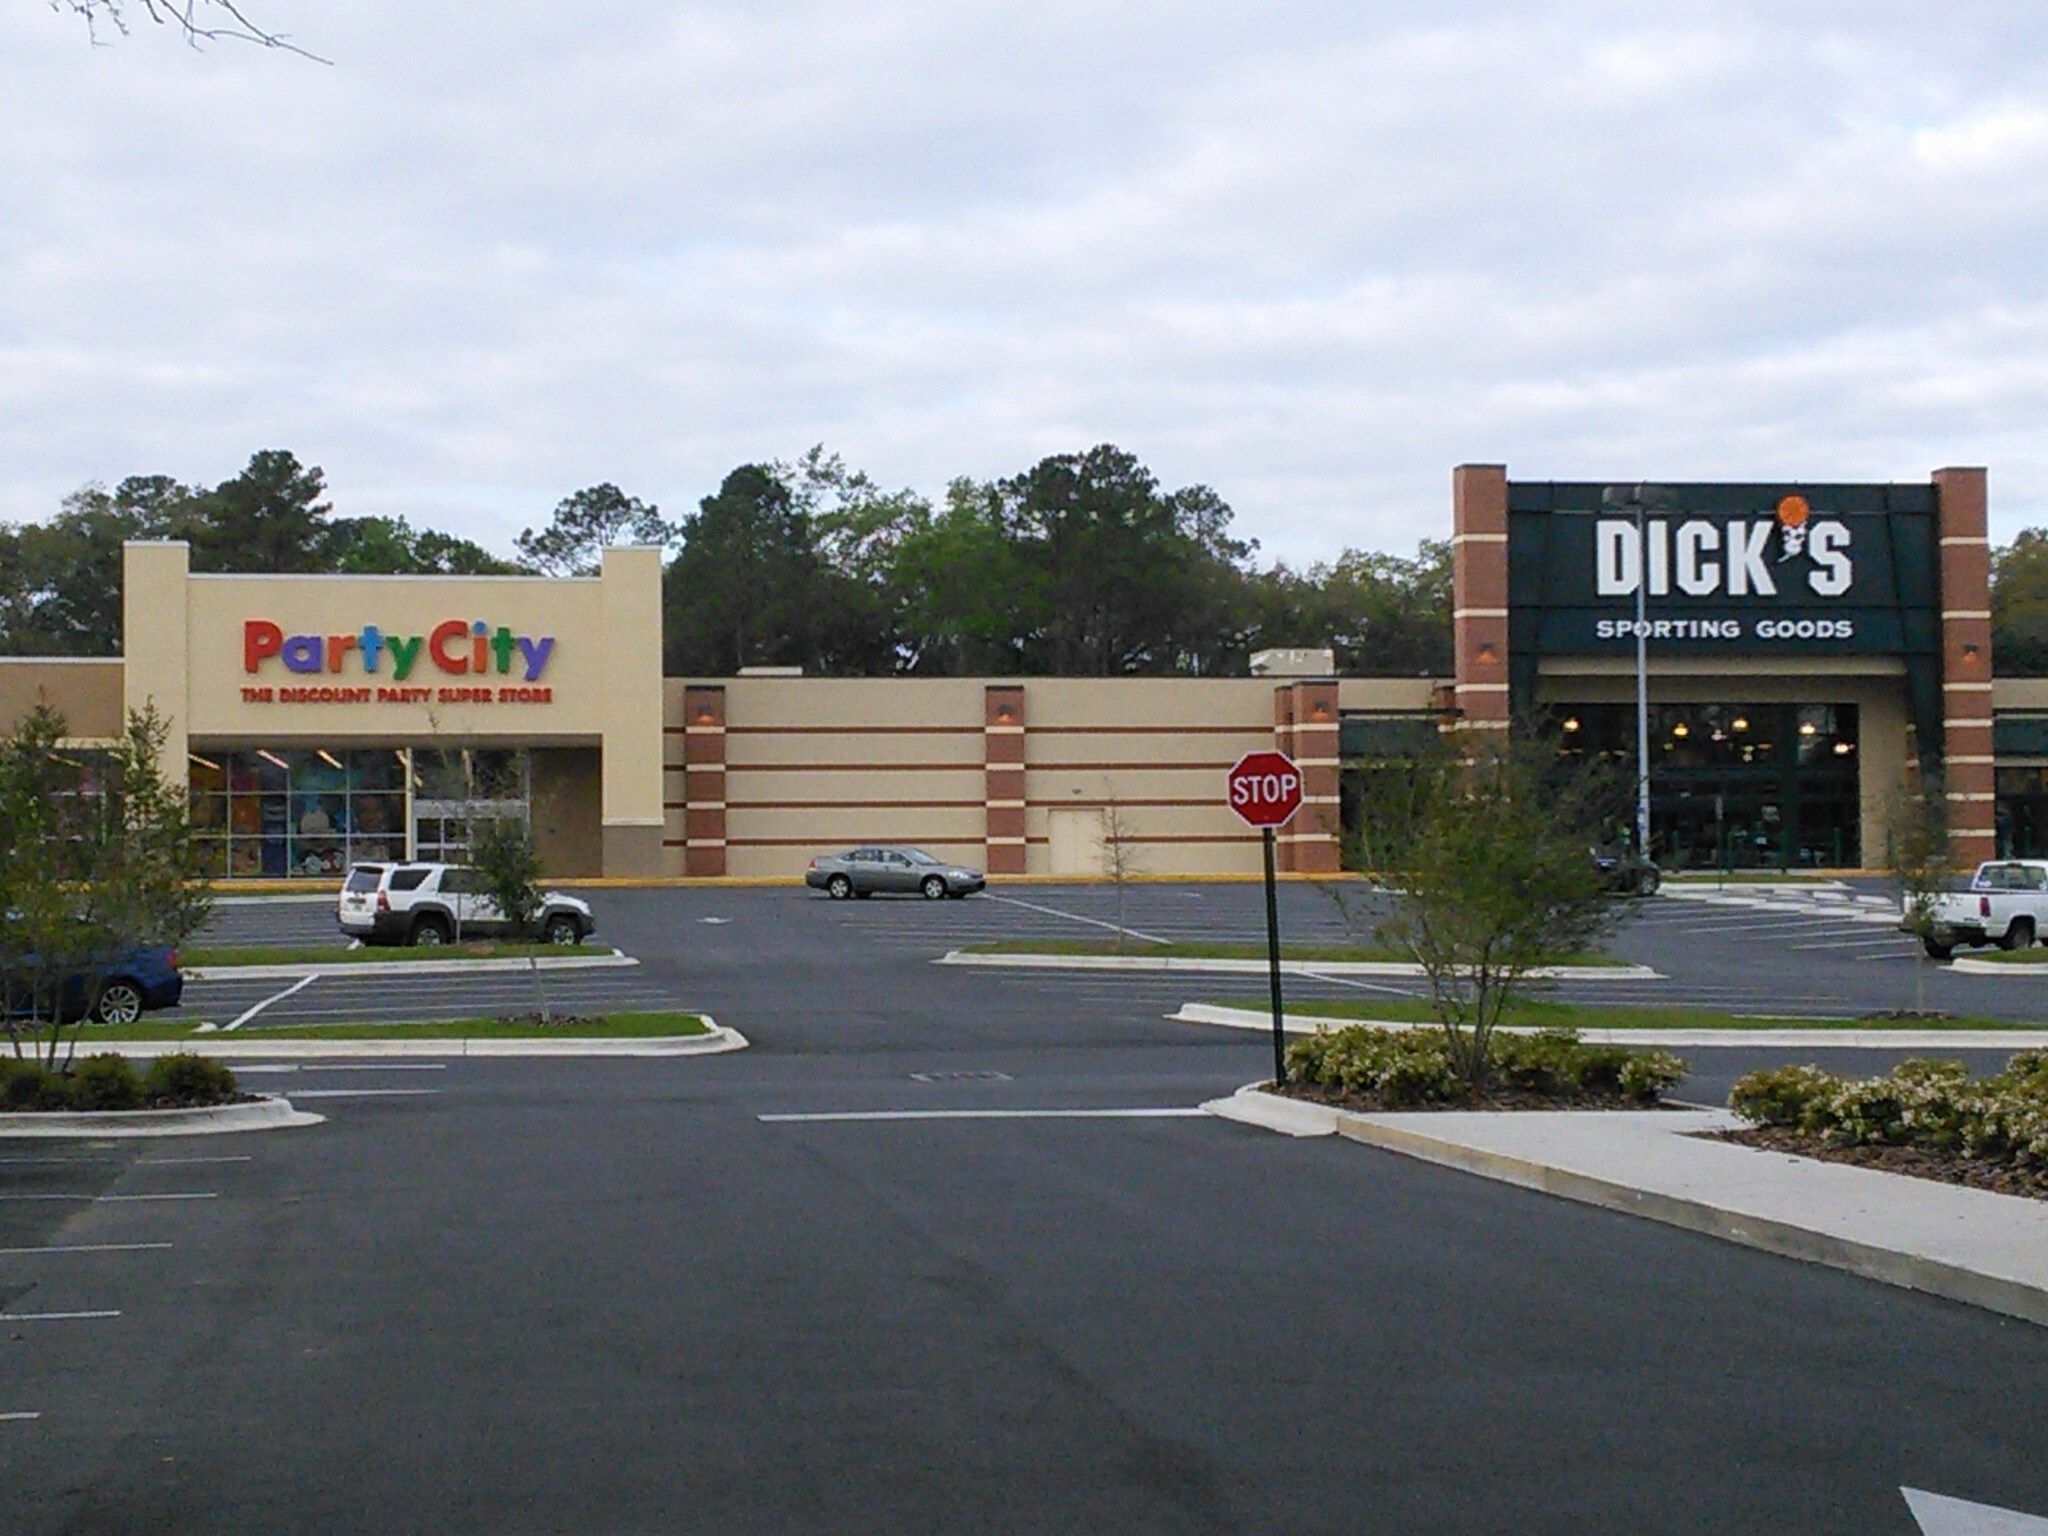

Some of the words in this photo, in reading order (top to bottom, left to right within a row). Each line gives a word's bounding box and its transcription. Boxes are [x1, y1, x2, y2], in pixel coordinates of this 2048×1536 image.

[1597, 519, 1853, 597] DICK'S
[1596, 619, 1741, 639] SPORTING
[1756, 619, 1853, 639] GOODS
[240, 687, 273, 703] THE
[279, 687, 371, 703] DISCOUNT
[377, 687, 431, 703] PARTY
[438, 687, 492, 703] SUPER
[498, 687, 552, 703] STORE
[1233, 773, 1297, 805] STOP
